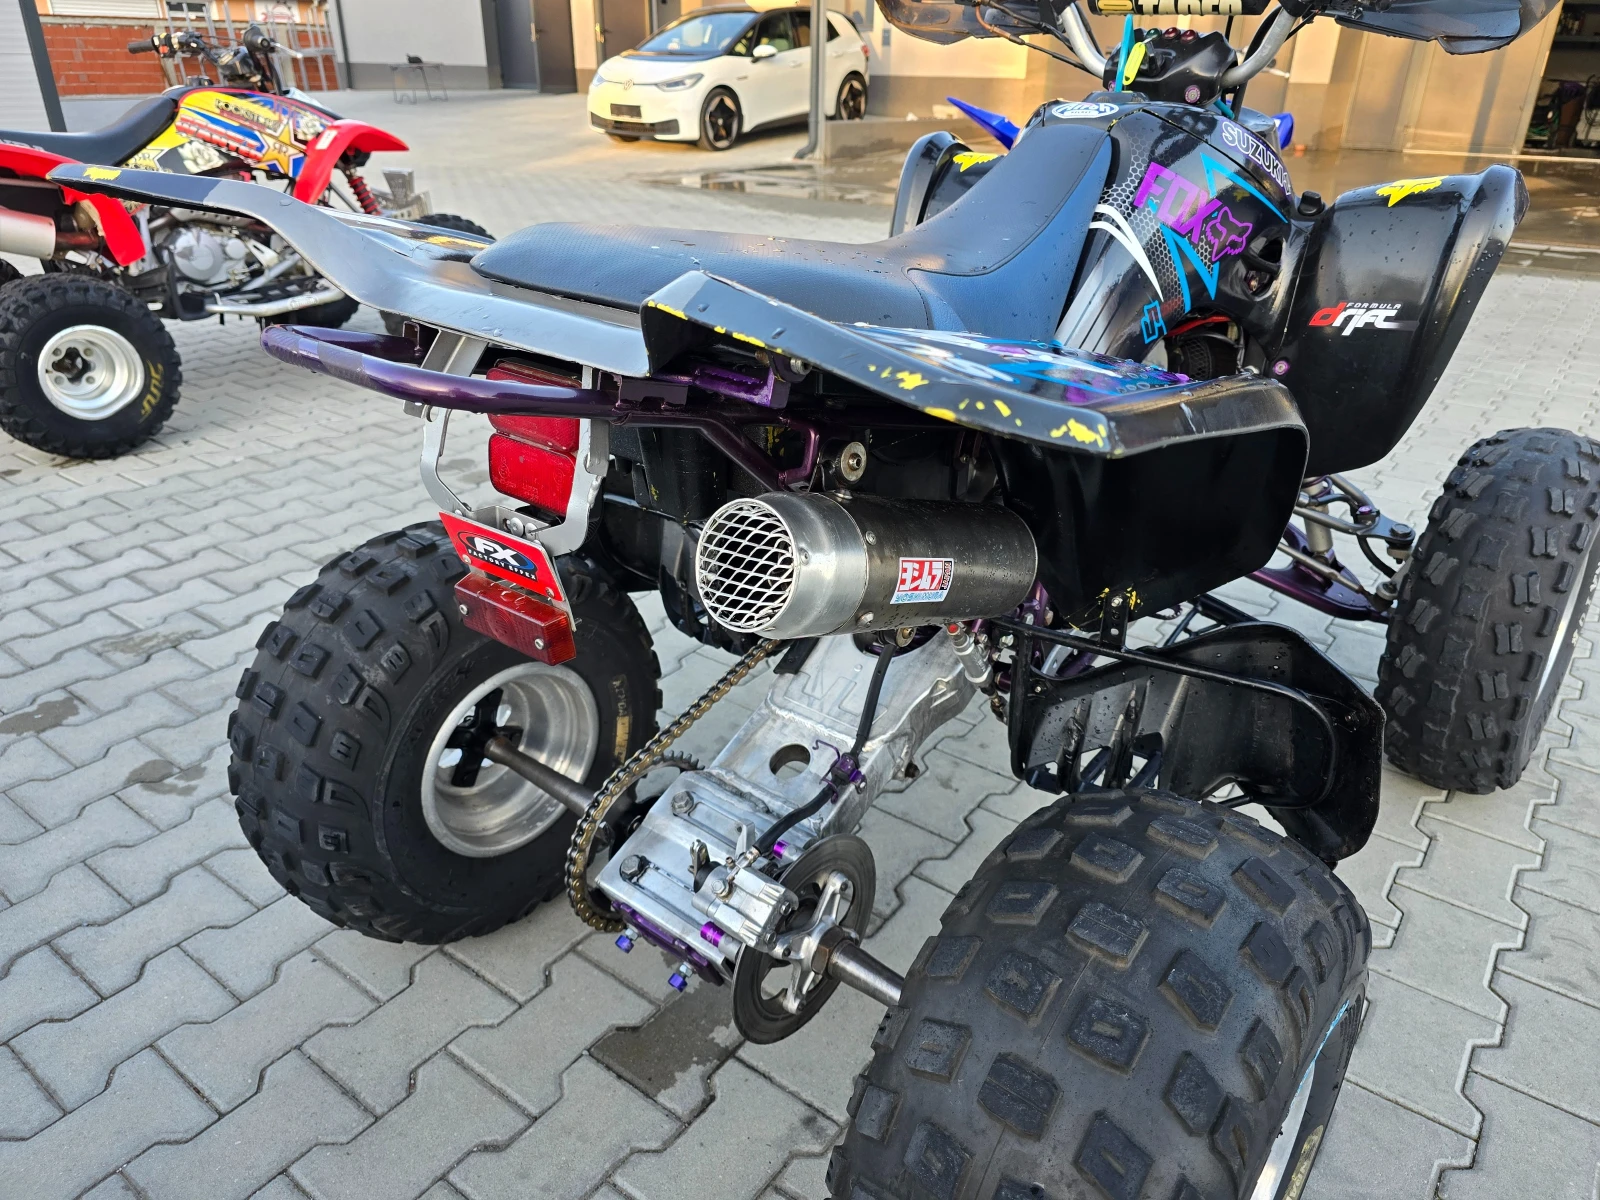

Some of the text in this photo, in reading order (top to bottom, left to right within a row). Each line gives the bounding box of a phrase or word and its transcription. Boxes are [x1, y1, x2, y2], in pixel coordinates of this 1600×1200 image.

[1222, 121, 1286, 186] SUZUKI
[1133, 161, 1223, 245] FOX
[1346, 302, 1402, 310] FORMULA
[468, 548, 505, 567] FACTORY
[473, 536, 521, 567] FX
